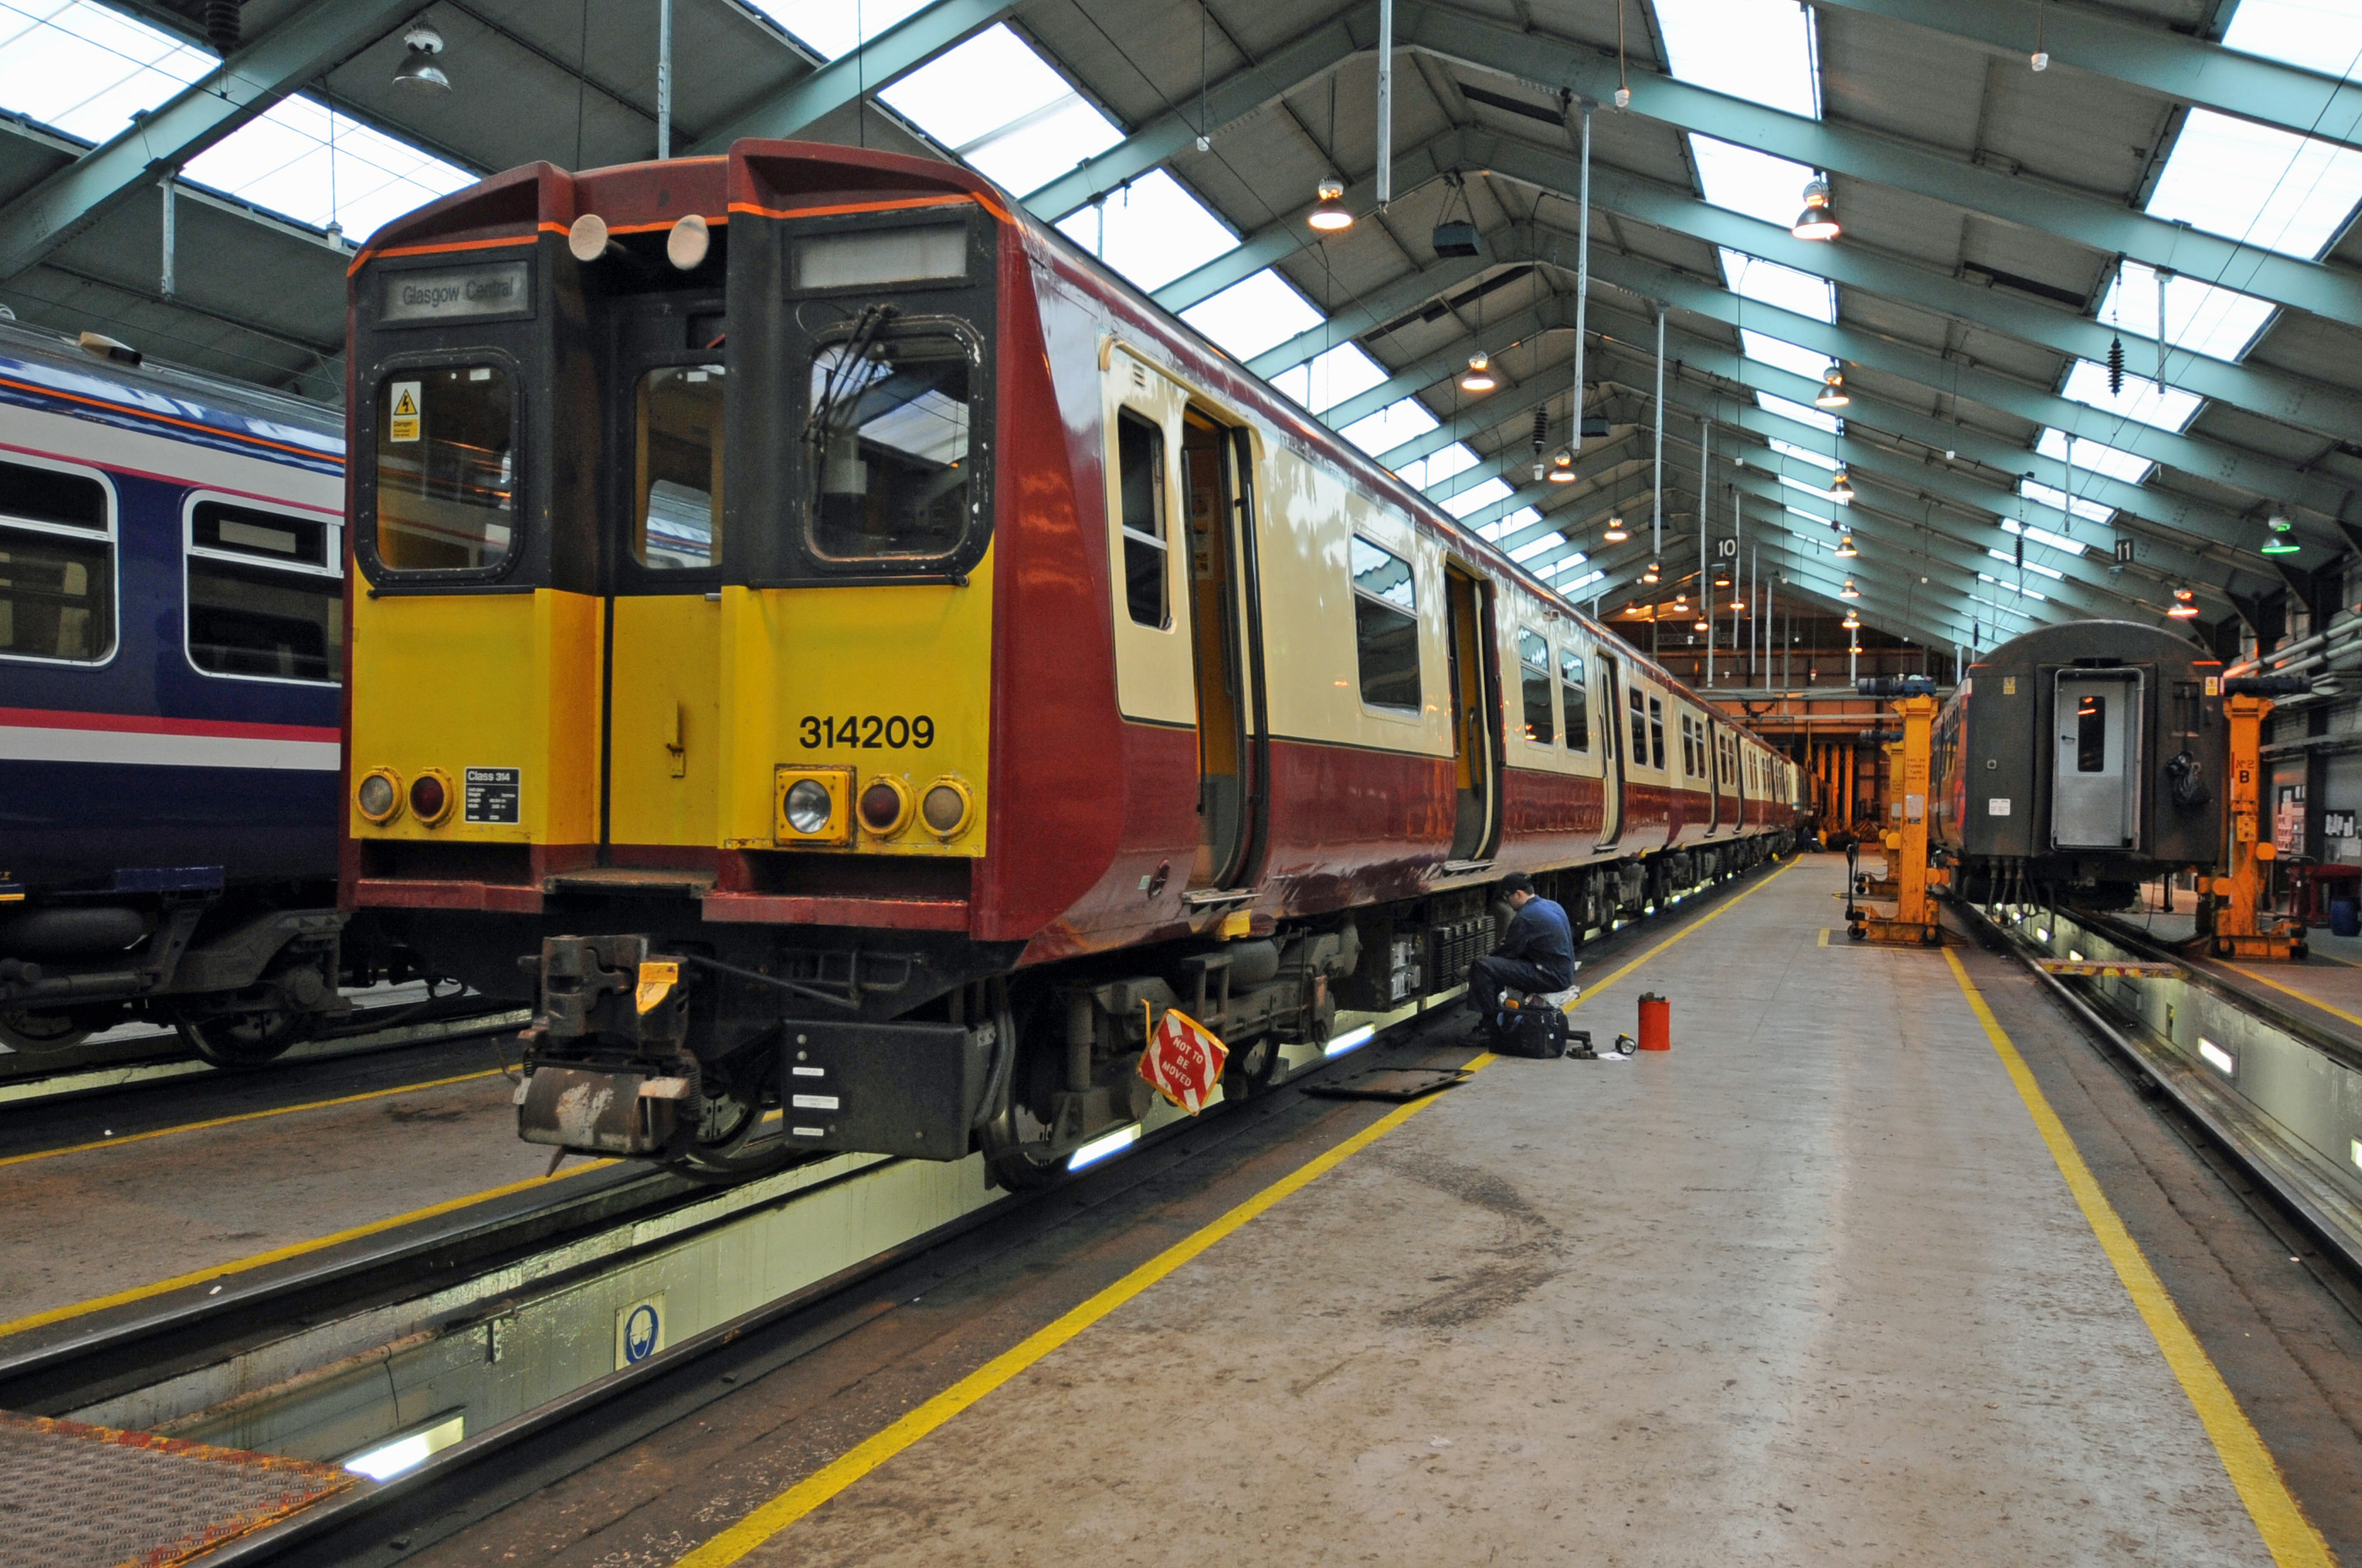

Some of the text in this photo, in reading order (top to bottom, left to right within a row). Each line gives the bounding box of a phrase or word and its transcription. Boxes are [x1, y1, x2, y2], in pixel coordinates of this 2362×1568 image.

[402, 277, 513, 307] Glasgow Central
[1718, 539, 1736, 557] 10
[2117, 541, 2130, 561] 11
[799, 715, 935, 748] 314209
[2247, 759, 2254, 769] 2
[468, 771, 510, 781] Class 314
[2239, 770, 2250, 783] B
[1173, 1037, 1204, 1065] NOT TO
[1176, 1055, 1189, 1070] BE
[1161, 1061, 1192, 1087] MOVED
